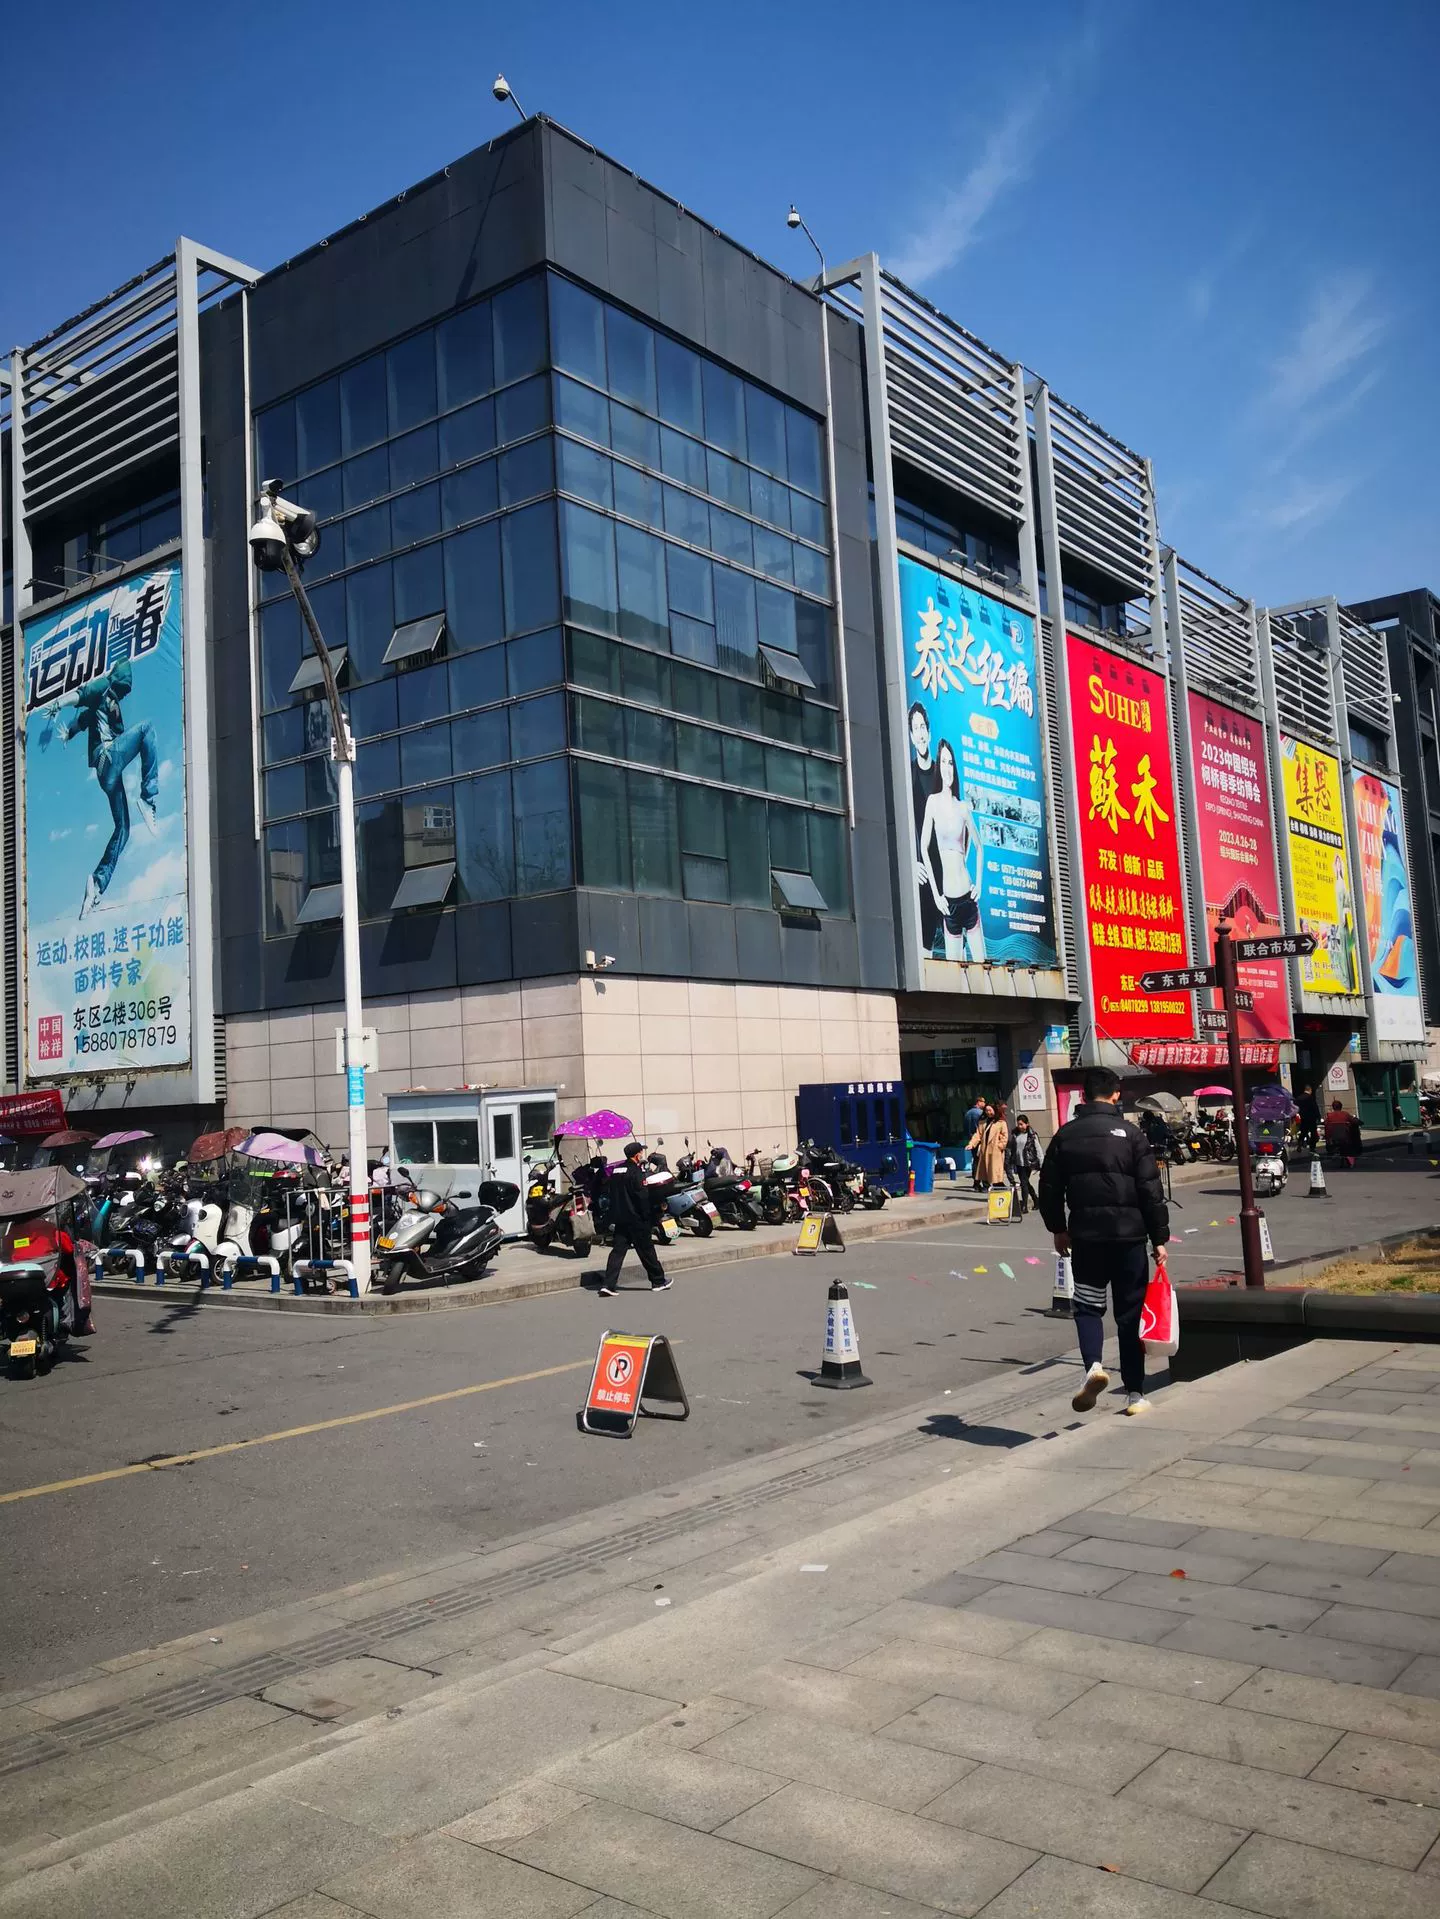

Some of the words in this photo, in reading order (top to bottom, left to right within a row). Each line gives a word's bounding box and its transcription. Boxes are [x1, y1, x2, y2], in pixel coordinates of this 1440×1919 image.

[1201, 740, 1257, 780] 2023中国绍兴
[1201, 763, 1261, 804] 柯桥春季纺博会
[1099, 848, 1117, 871] 开发
[1123, 853, 1141, 876] 创新
[1147, 858, 1164, 880] 品质
[1243, 940, 1297, 957] 联合市场
[74, 957, 142, 993] 面料专家
[1162, 971, 1207, 987] 东市场
[40, 1018, 61, 1036] 中国
[73, 996, 172, 1030] 东区2楼306号
[73, 1025, 176, 1054] 15880787879
